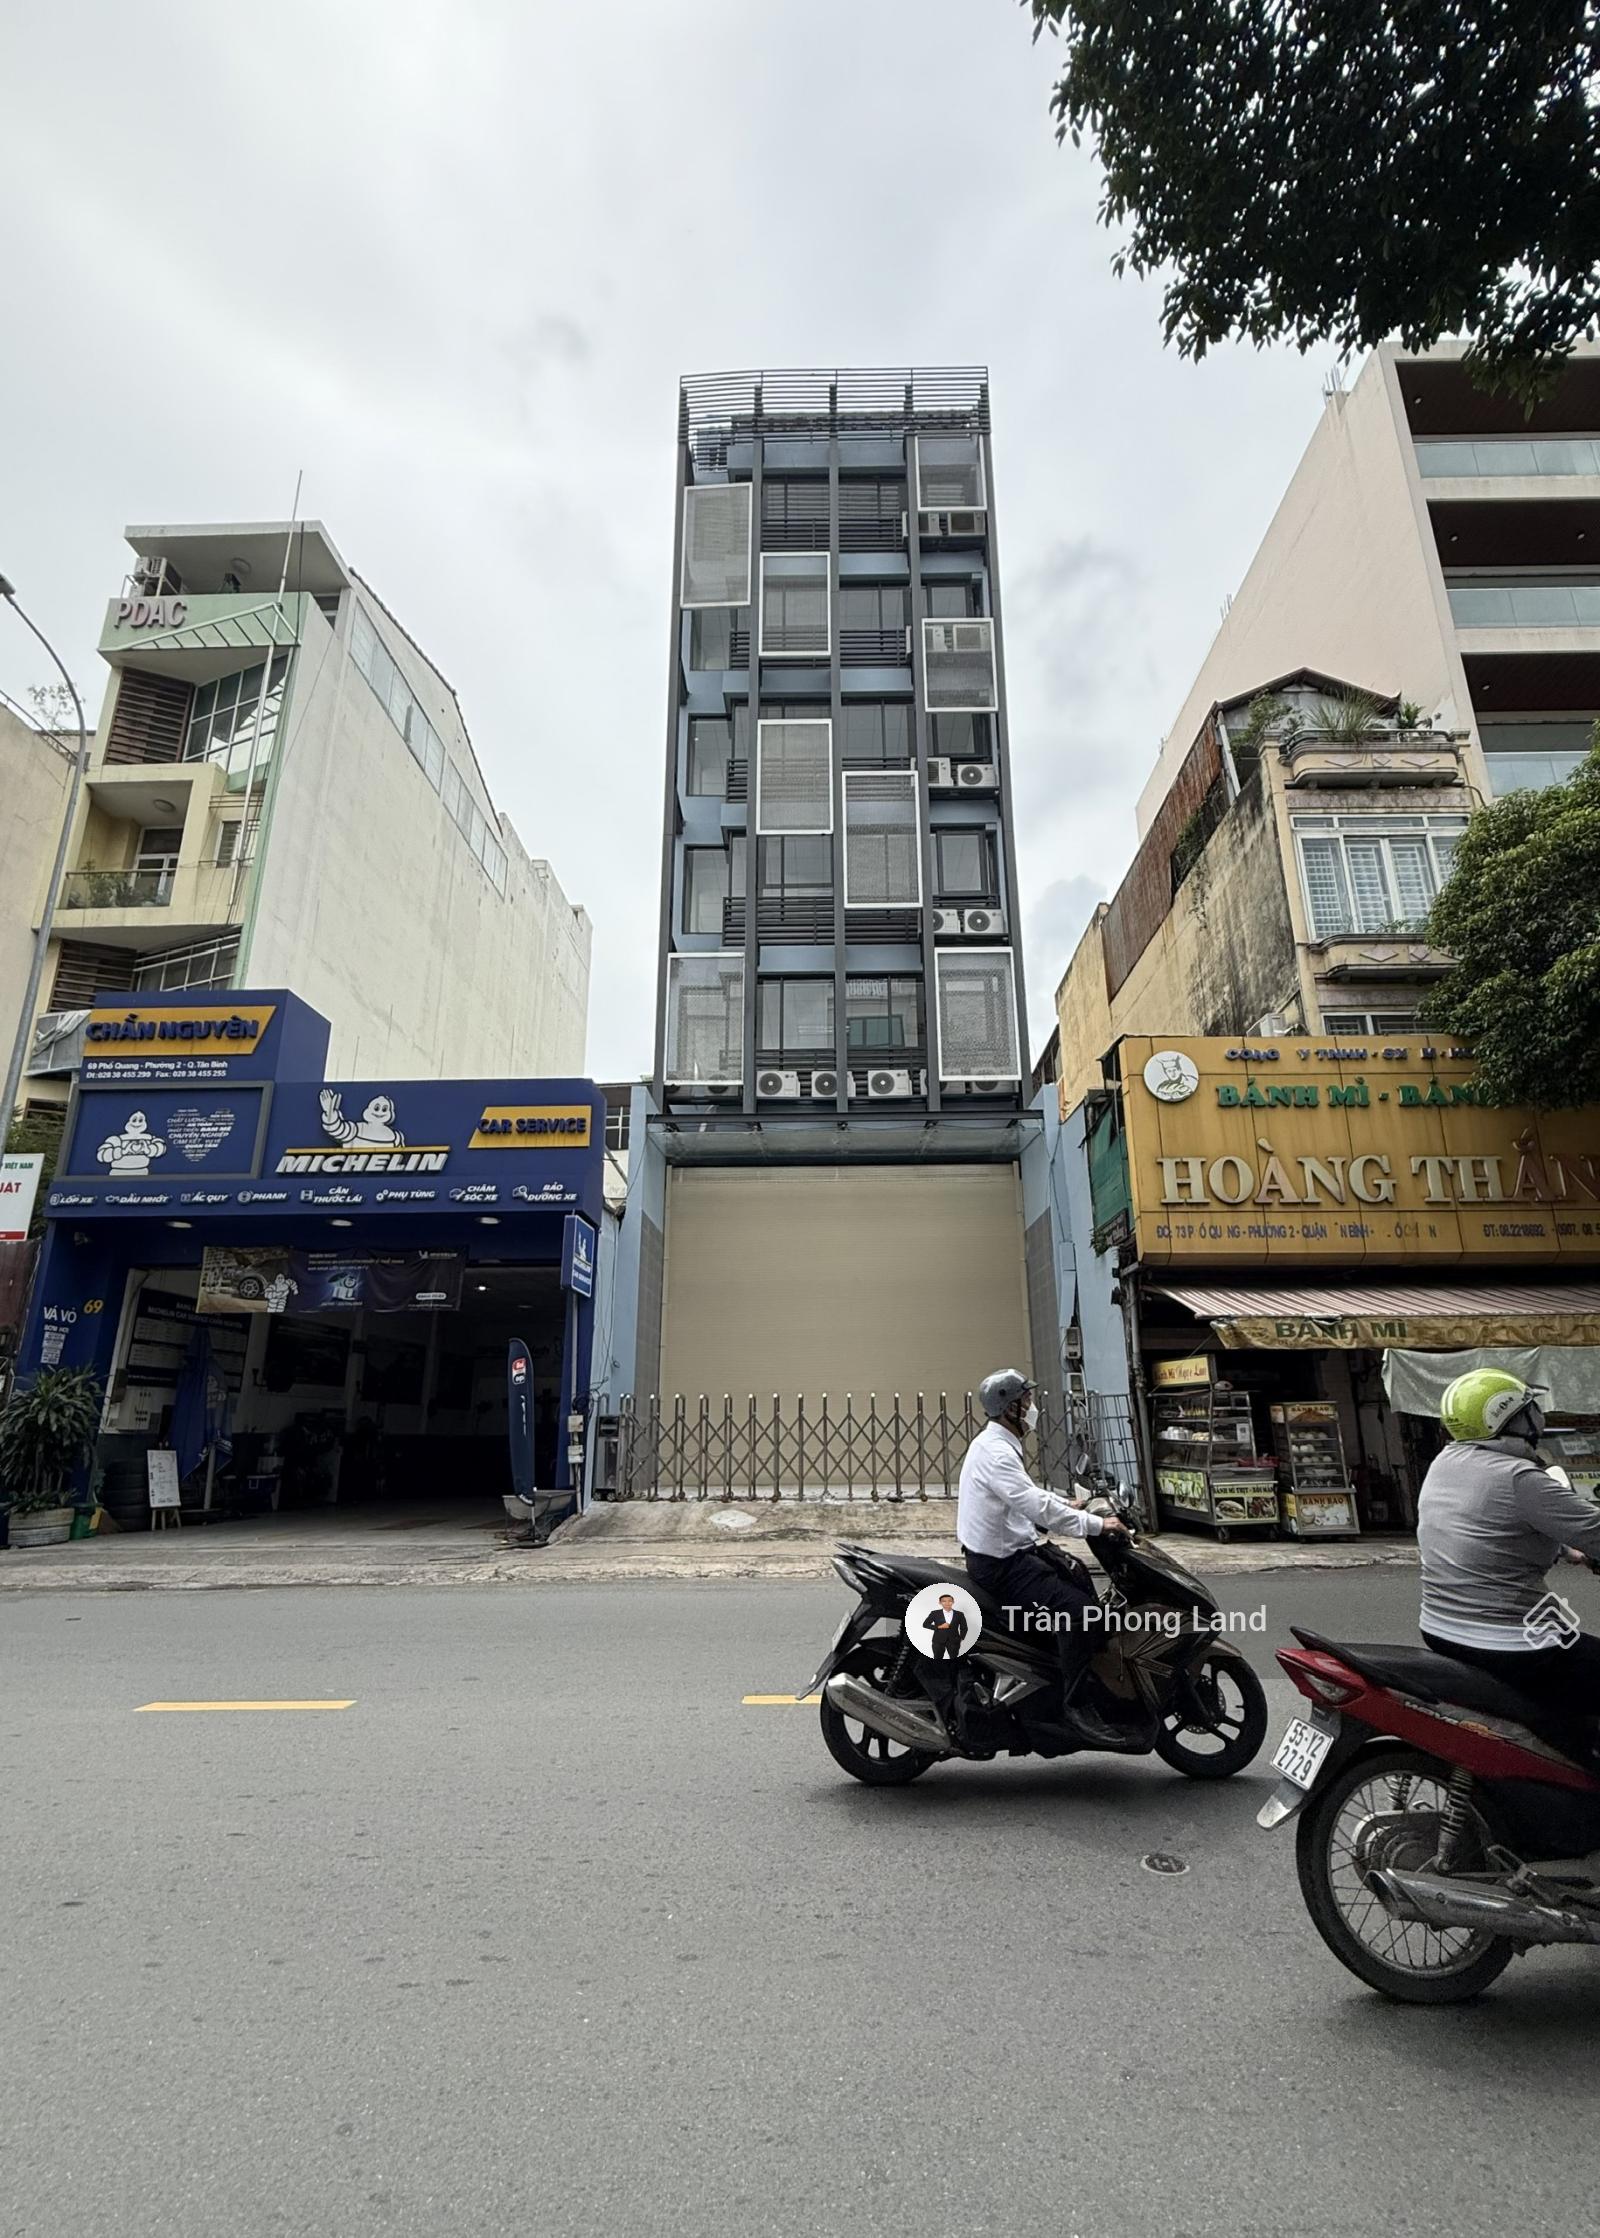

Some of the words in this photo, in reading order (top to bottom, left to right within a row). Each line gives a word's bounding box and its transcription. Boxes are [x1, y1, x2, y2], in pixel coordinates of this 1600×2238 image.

[113, 599, 187, 629] PDAC
[158, 1015, 260, 1041] NGUYÊN
[1316, 1047, 1367, 1061] TNHH
[114, 1062, 140, 1071] Quang
[176, 1061, 182, 1069] 2
[1327, 1076, 1370, 1107] MÌ
[477, 1118, 513, 1135] CAR
[515, 1116, 588, 1134] SERVICE
[275, 1153, 449, 1174] MICHELIN
[1155, 1137, 1398, 1205] HOÀNG
[79, 1195, 94, 1204] XE
[206, 1194, 228, 1203] QUY
[251, 1192, 288, 1201] PHANH
[485, 1192, 498, 1201] XE
[562, 1193, 577, 1201] XE
[1175, 1225, 1186, 1238] 73
[1248, 1221, 1287, 1239] PHƯỜNG
[1289, 1226, 1296, 1238] 2
[1302, 1222, 1327, 1240] QUẬN
[43, 1305, 58, 1321] VÁ
[84, 1299, 104, 1314] 69
[1288, 1721, 1325, 1759] 55-Y2
[1277, 1744, 1313, 1782] 2729
